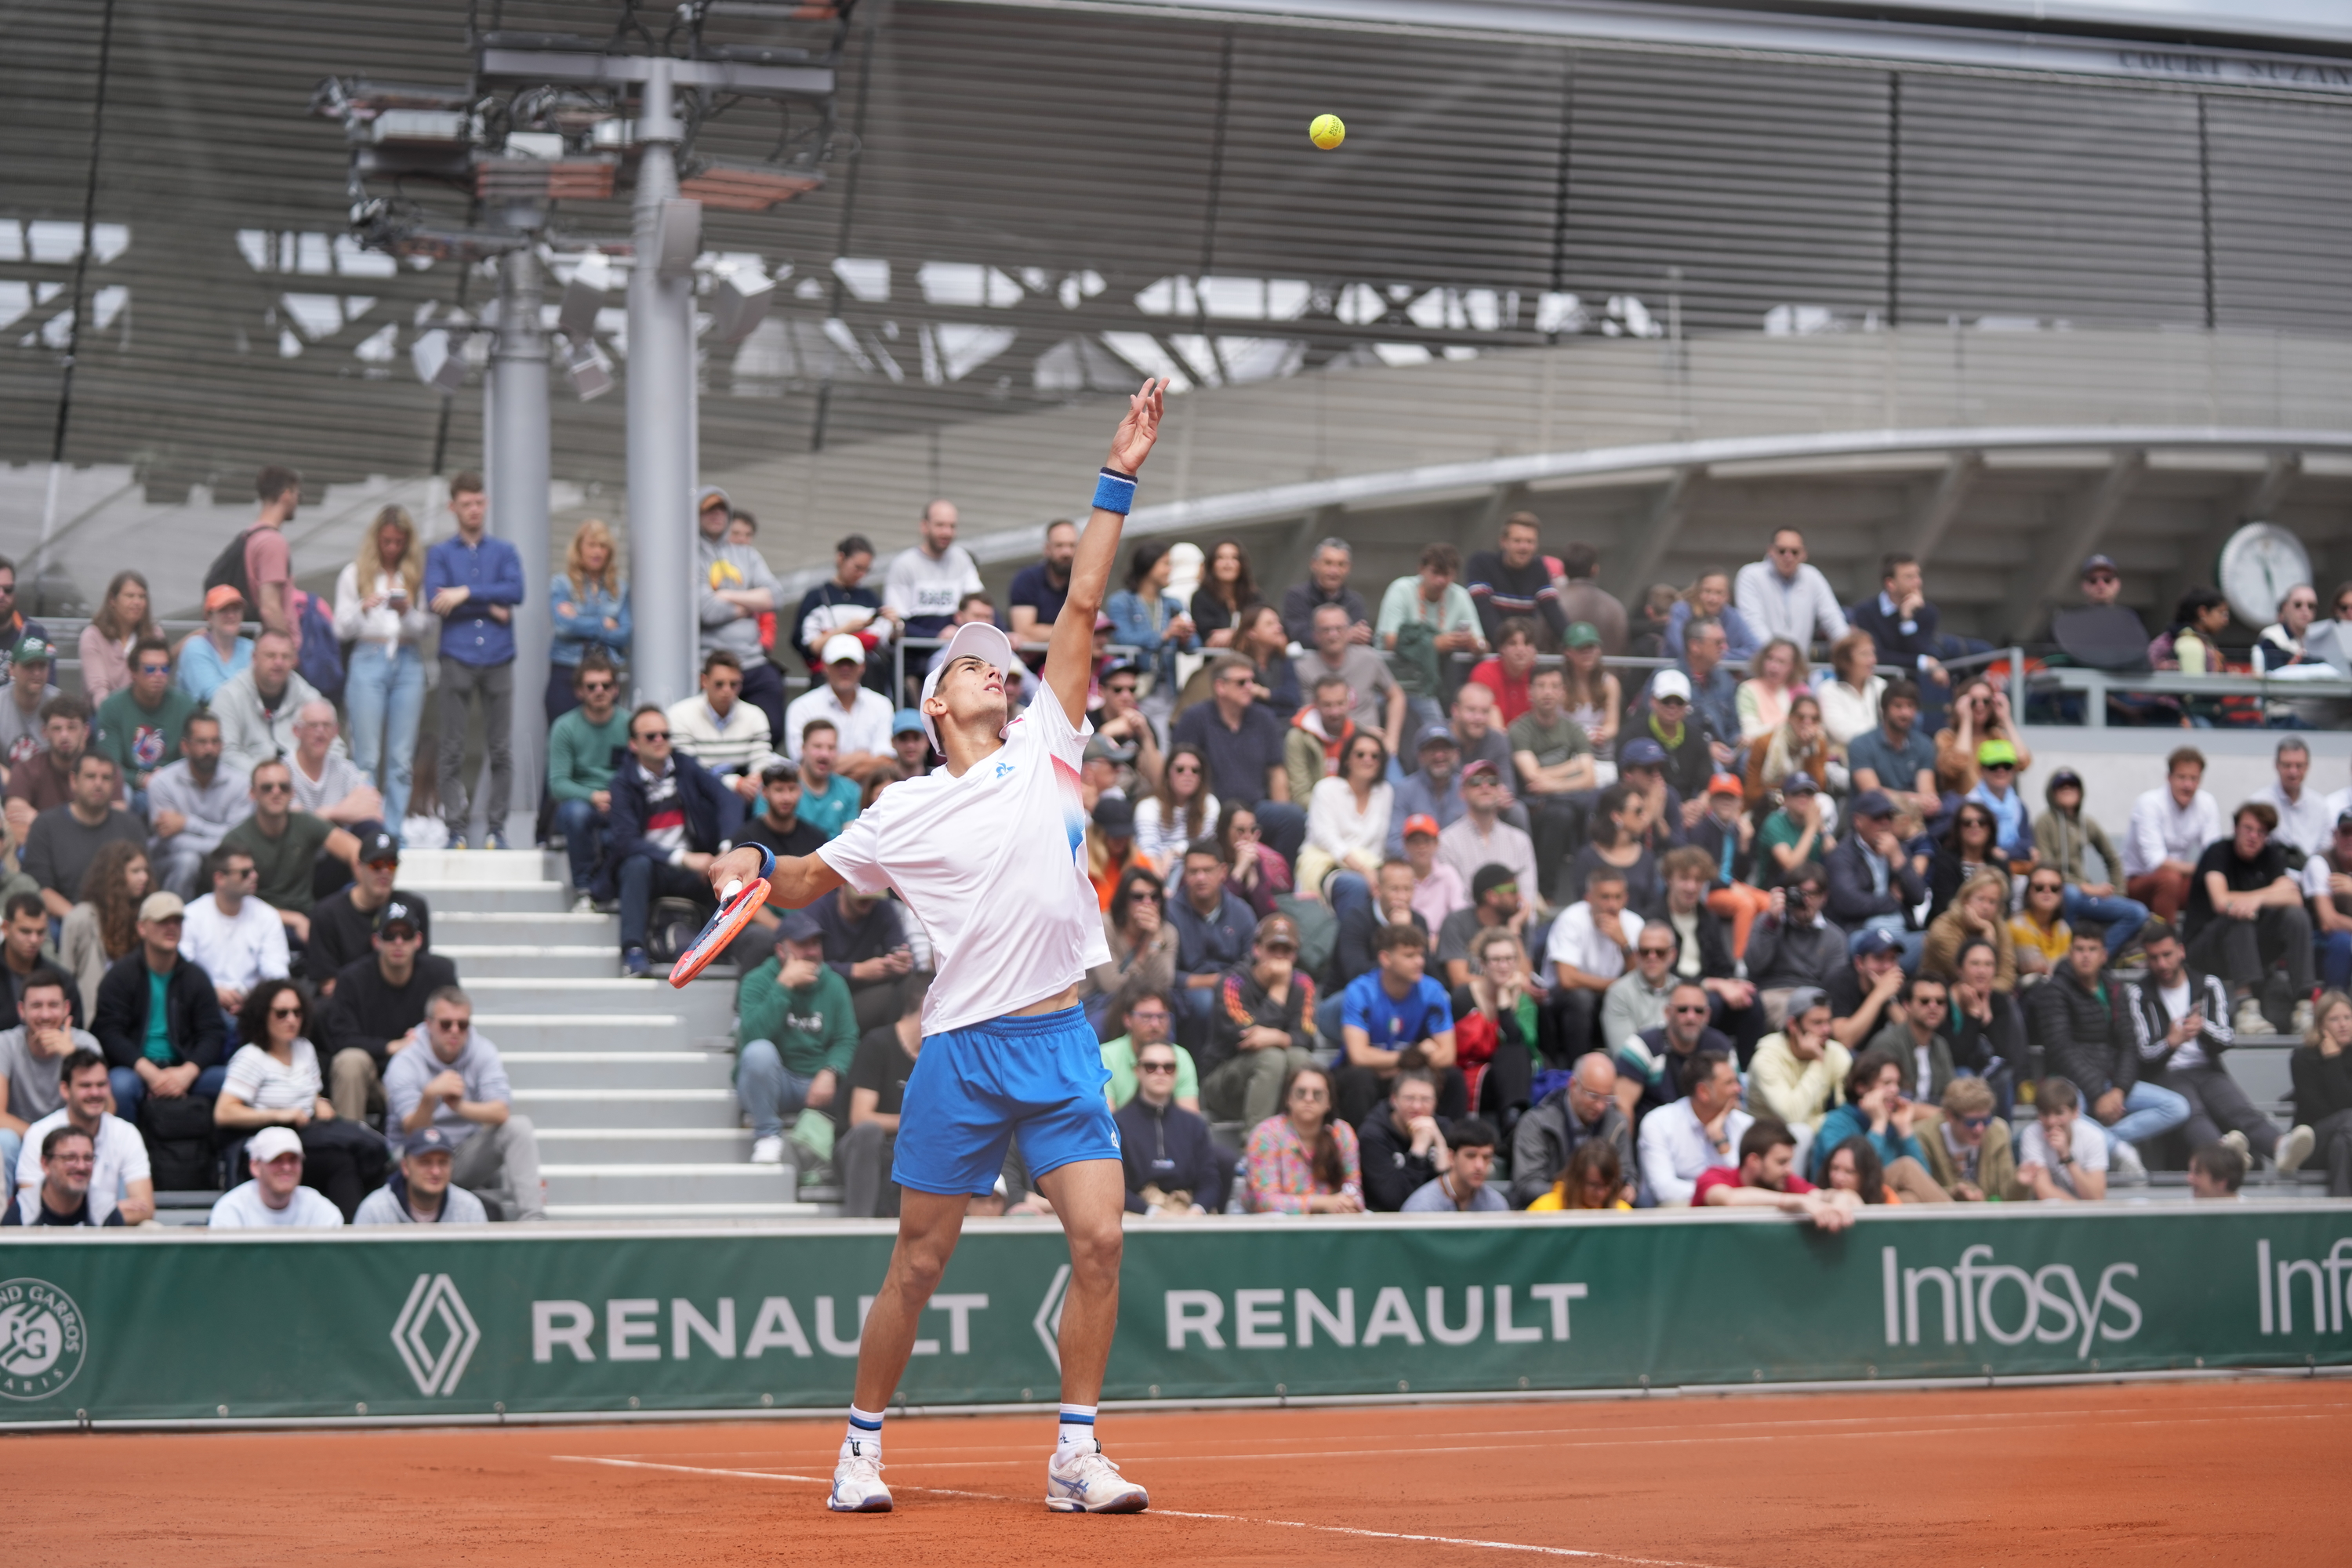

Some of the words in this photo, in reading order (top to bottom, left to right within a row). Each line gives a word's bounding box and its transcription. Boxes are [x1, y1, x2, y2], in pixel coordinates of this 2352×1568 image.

[2118, 51, 2221, 74] COURT
[1164, 1283, 1588, 1349] RENAULT
[1882, 1243, 2143, 1360] Infosys
[2256, 1236, 2352, 1334] Inf
[29, 1286, 80, 1353] GARROS
[2, 1368, 64, 1392] ARIS
